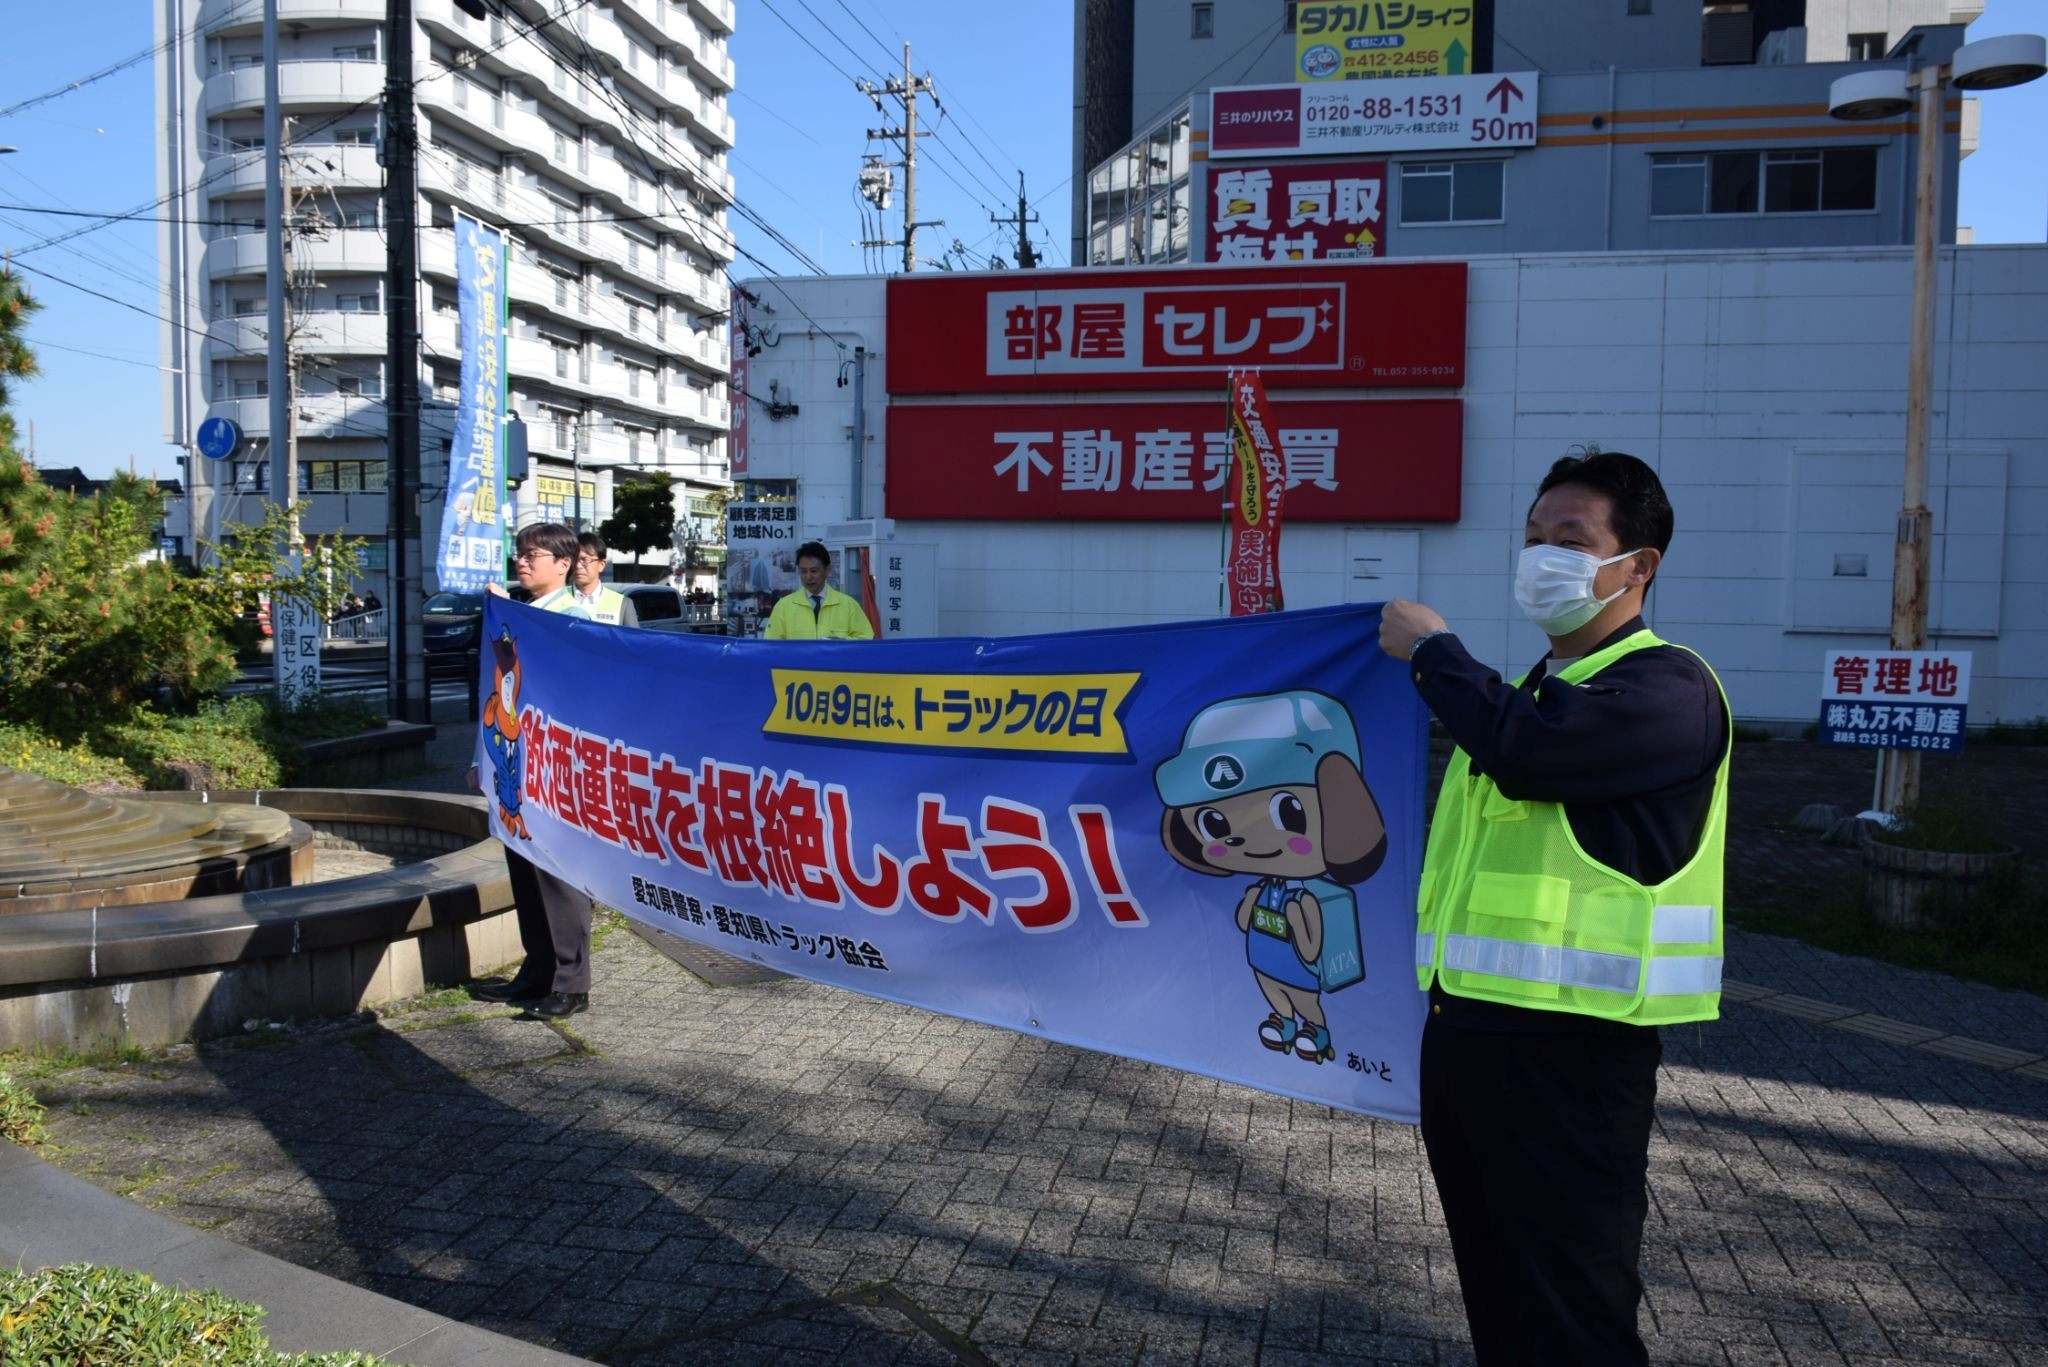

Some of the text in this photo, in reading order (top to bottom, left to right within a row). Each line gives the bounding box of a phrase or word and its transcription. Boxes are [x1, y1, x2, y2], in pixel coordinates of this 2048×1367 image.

[1300, 2, 1471, 35] タカハシライフ
[1350, 37, 1399, 49] 女性に人気
[1307, 94, 1350, 104] フリーコール
[1219, 111, 1294, 125] 三井のリハウス
[1306, 120, 1460, 139] 三井不動産リアルティ株式会社
[1470, 117, 1534, 143] 50m
[733, 525, 794, 540] 地域No.1
[1235, 529, 1264, 613] 実施中
[889, 556, 902, 632] 証明写真
[1833, 656, 1958, 698] 管理地
[784, 682, 1108, 739] 10月9日は、トラックの日
[1255, 909, 1285, 935] あいち
[1328, 950, 1357, 980] ATA
[1347, 1051, 1393, 1083] あいと
